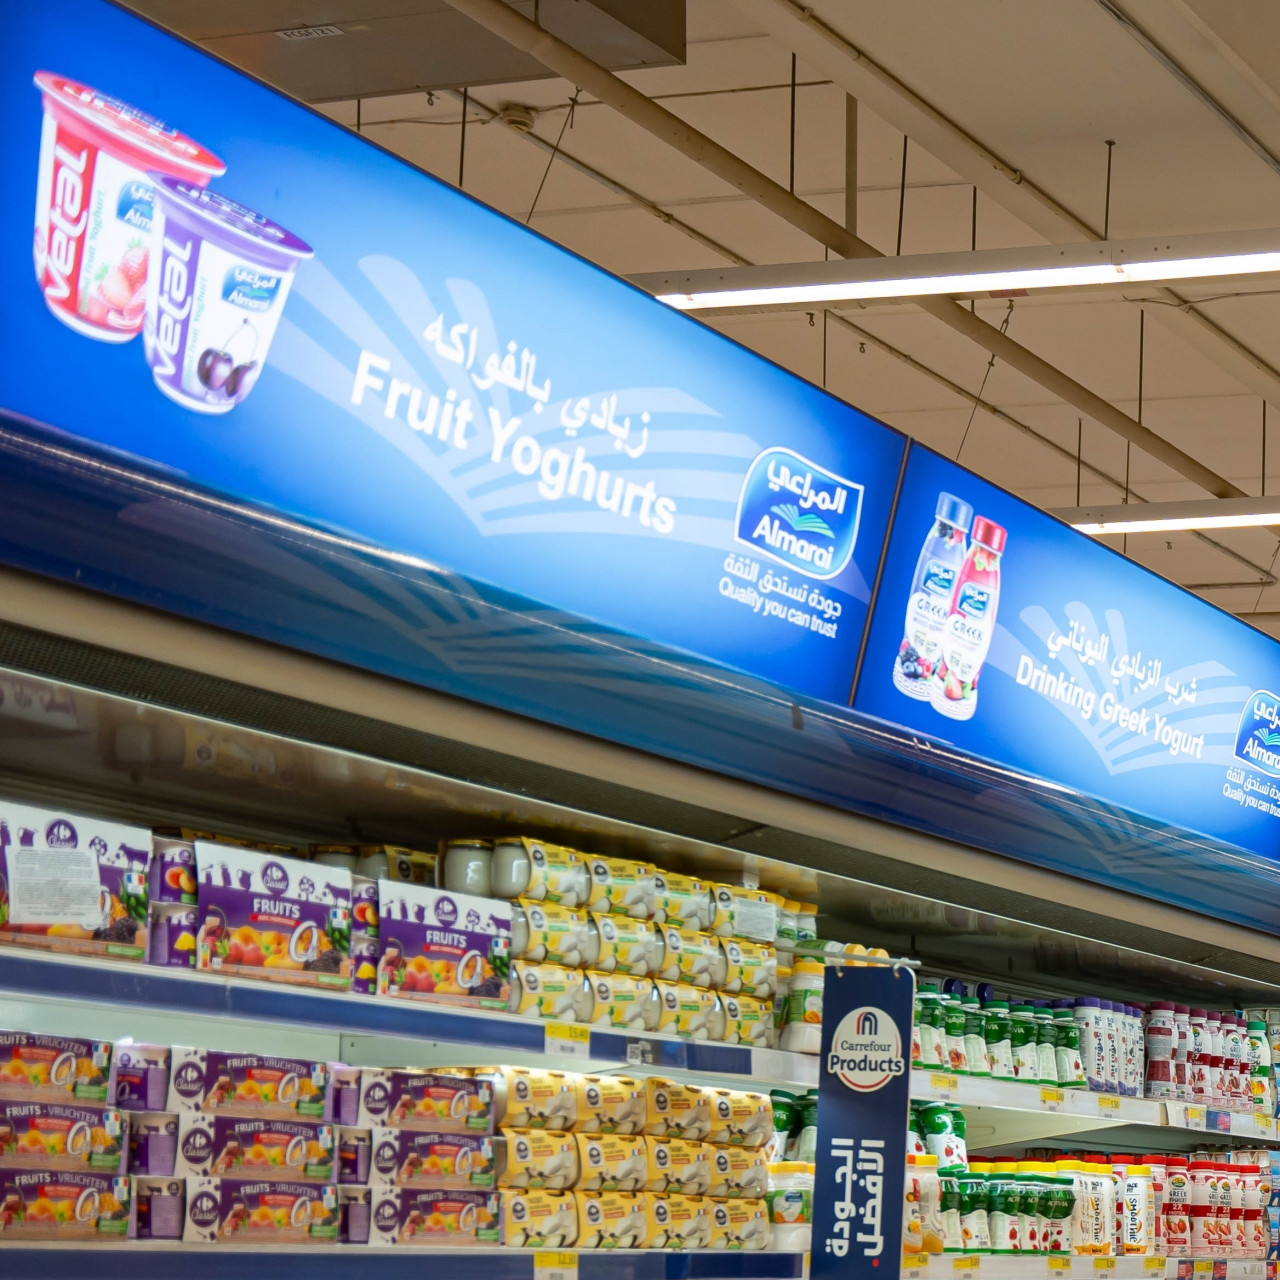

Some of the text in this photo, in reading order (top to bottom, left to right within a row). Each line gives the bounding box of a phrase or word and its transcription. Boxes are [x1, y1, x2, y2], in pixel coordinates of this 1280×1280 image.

[422, 313, 651, 459] زبادي بالفواكه
[351, 350, 678, 535] Fruit Yoghurts
[767, 460, 846, 514] المراعي
[751, 514, 835, 571] Almarai
[718, 577, 839, 639] Quality you can trust
[723, 554, 843, 618] جودة تستحق الثقة
[1047, 621, 1198, 704] شرب الزبادي اليوناني
[1016, 655, 1205, 759] Drinking Greek Yogurt
[253, 898, 301, 918] FRUITS
[425, 930, 468, 949] FRUITS
[226, 1057, 307, 1075] FRUITS VRUCHTEN
[828, 1053, 903, 1075] Products
[840, 1040, 892, 1055] Carrefour
[5, 1105, 99, 1124] FRUITS VRUCHTEN
[14, 1172, 108, 1190] FRUITS VRUCHTEN
[826, 1138, 855, 1257] الجودة
